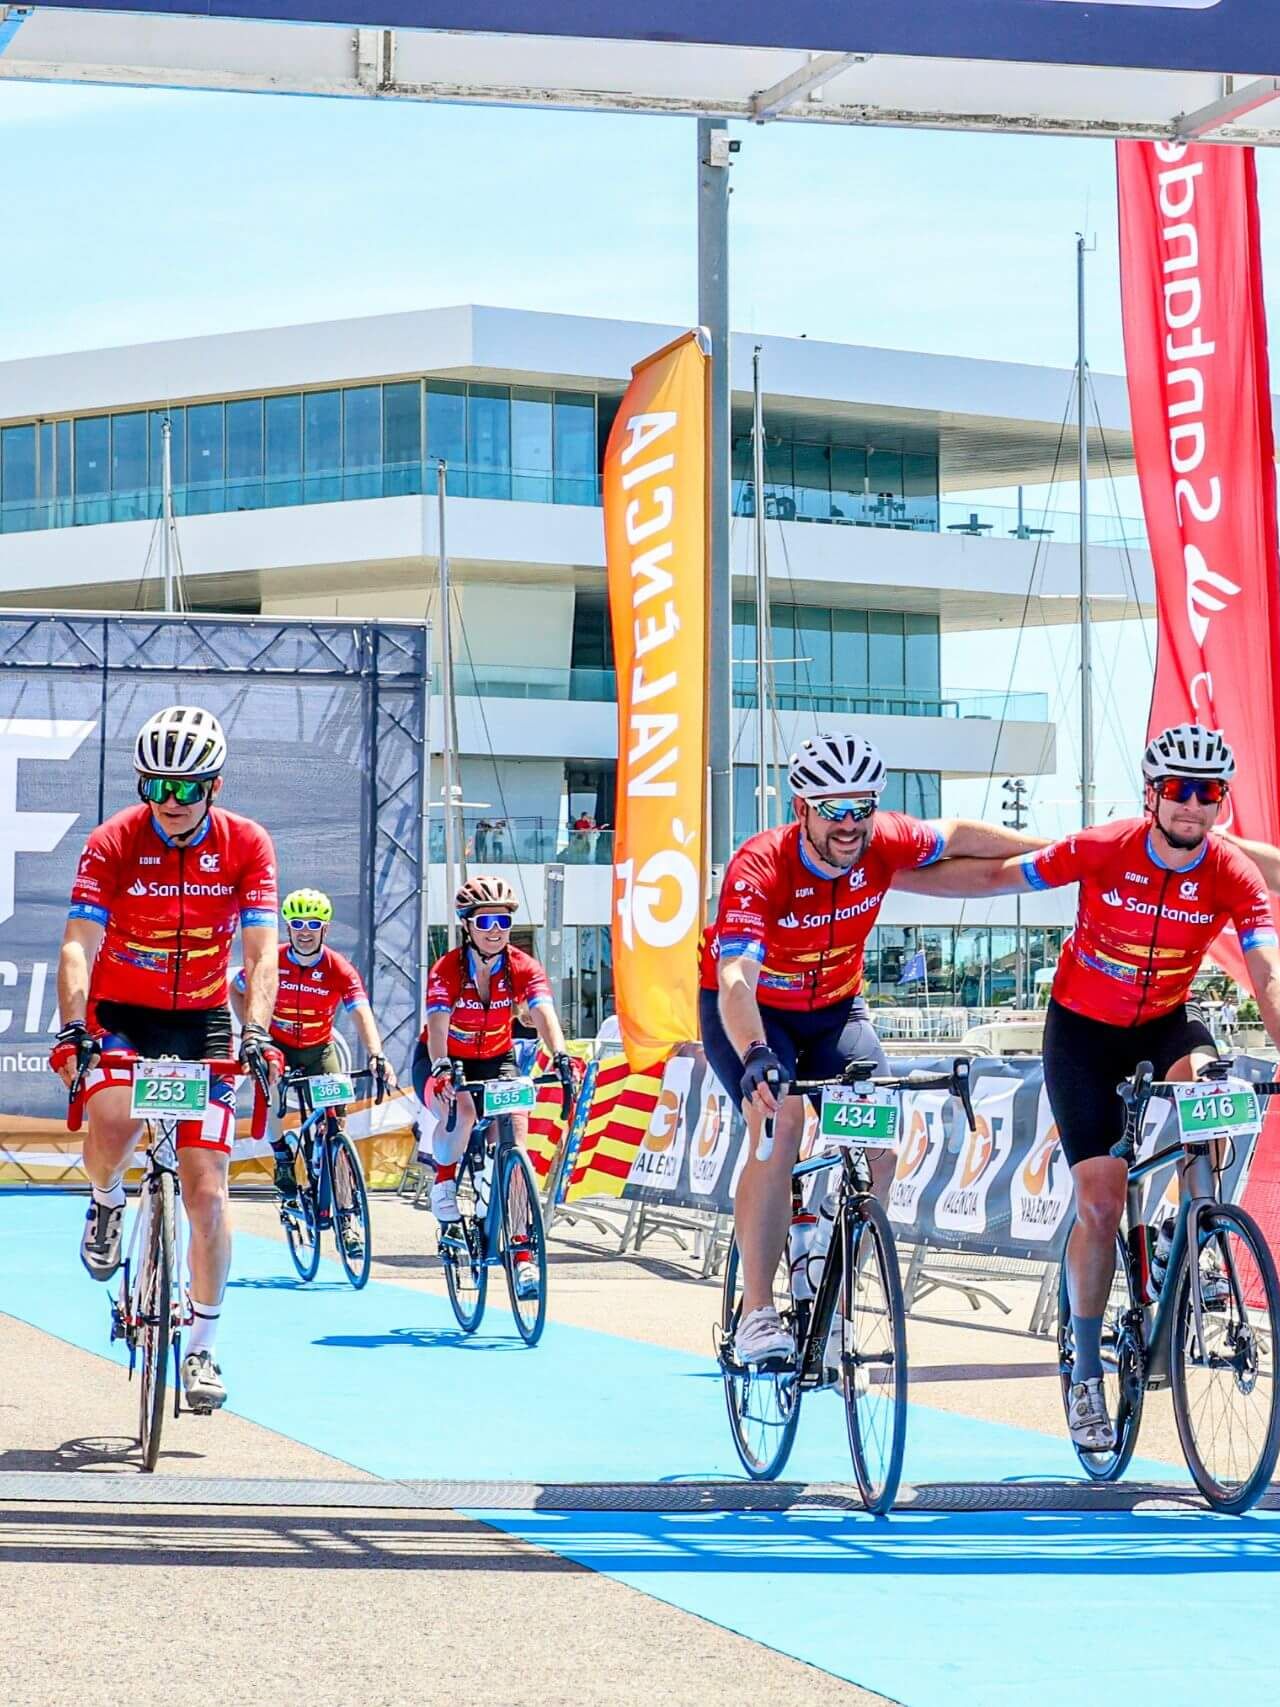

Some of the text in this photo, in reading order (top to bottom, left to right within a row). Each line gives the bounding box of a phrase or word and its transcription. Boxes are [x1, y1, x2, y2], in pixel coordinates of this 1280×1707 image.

[1125, 872, 1149, 885] GOBIK
[149, 881, 235, 896] Santander
[801, 891, 882, 929] Santander
[1124, 897, 1215, 924] Santander
[280, 981, 330, 996] Santander
[144, 1080, 186, 1102] 253
[318, 1085, 341, 1097] 366
[493, 1091, 520, 1105] 635
[833, 1105, 877, 1128] 434
[1191, 1097, 1235, 1120] 416
